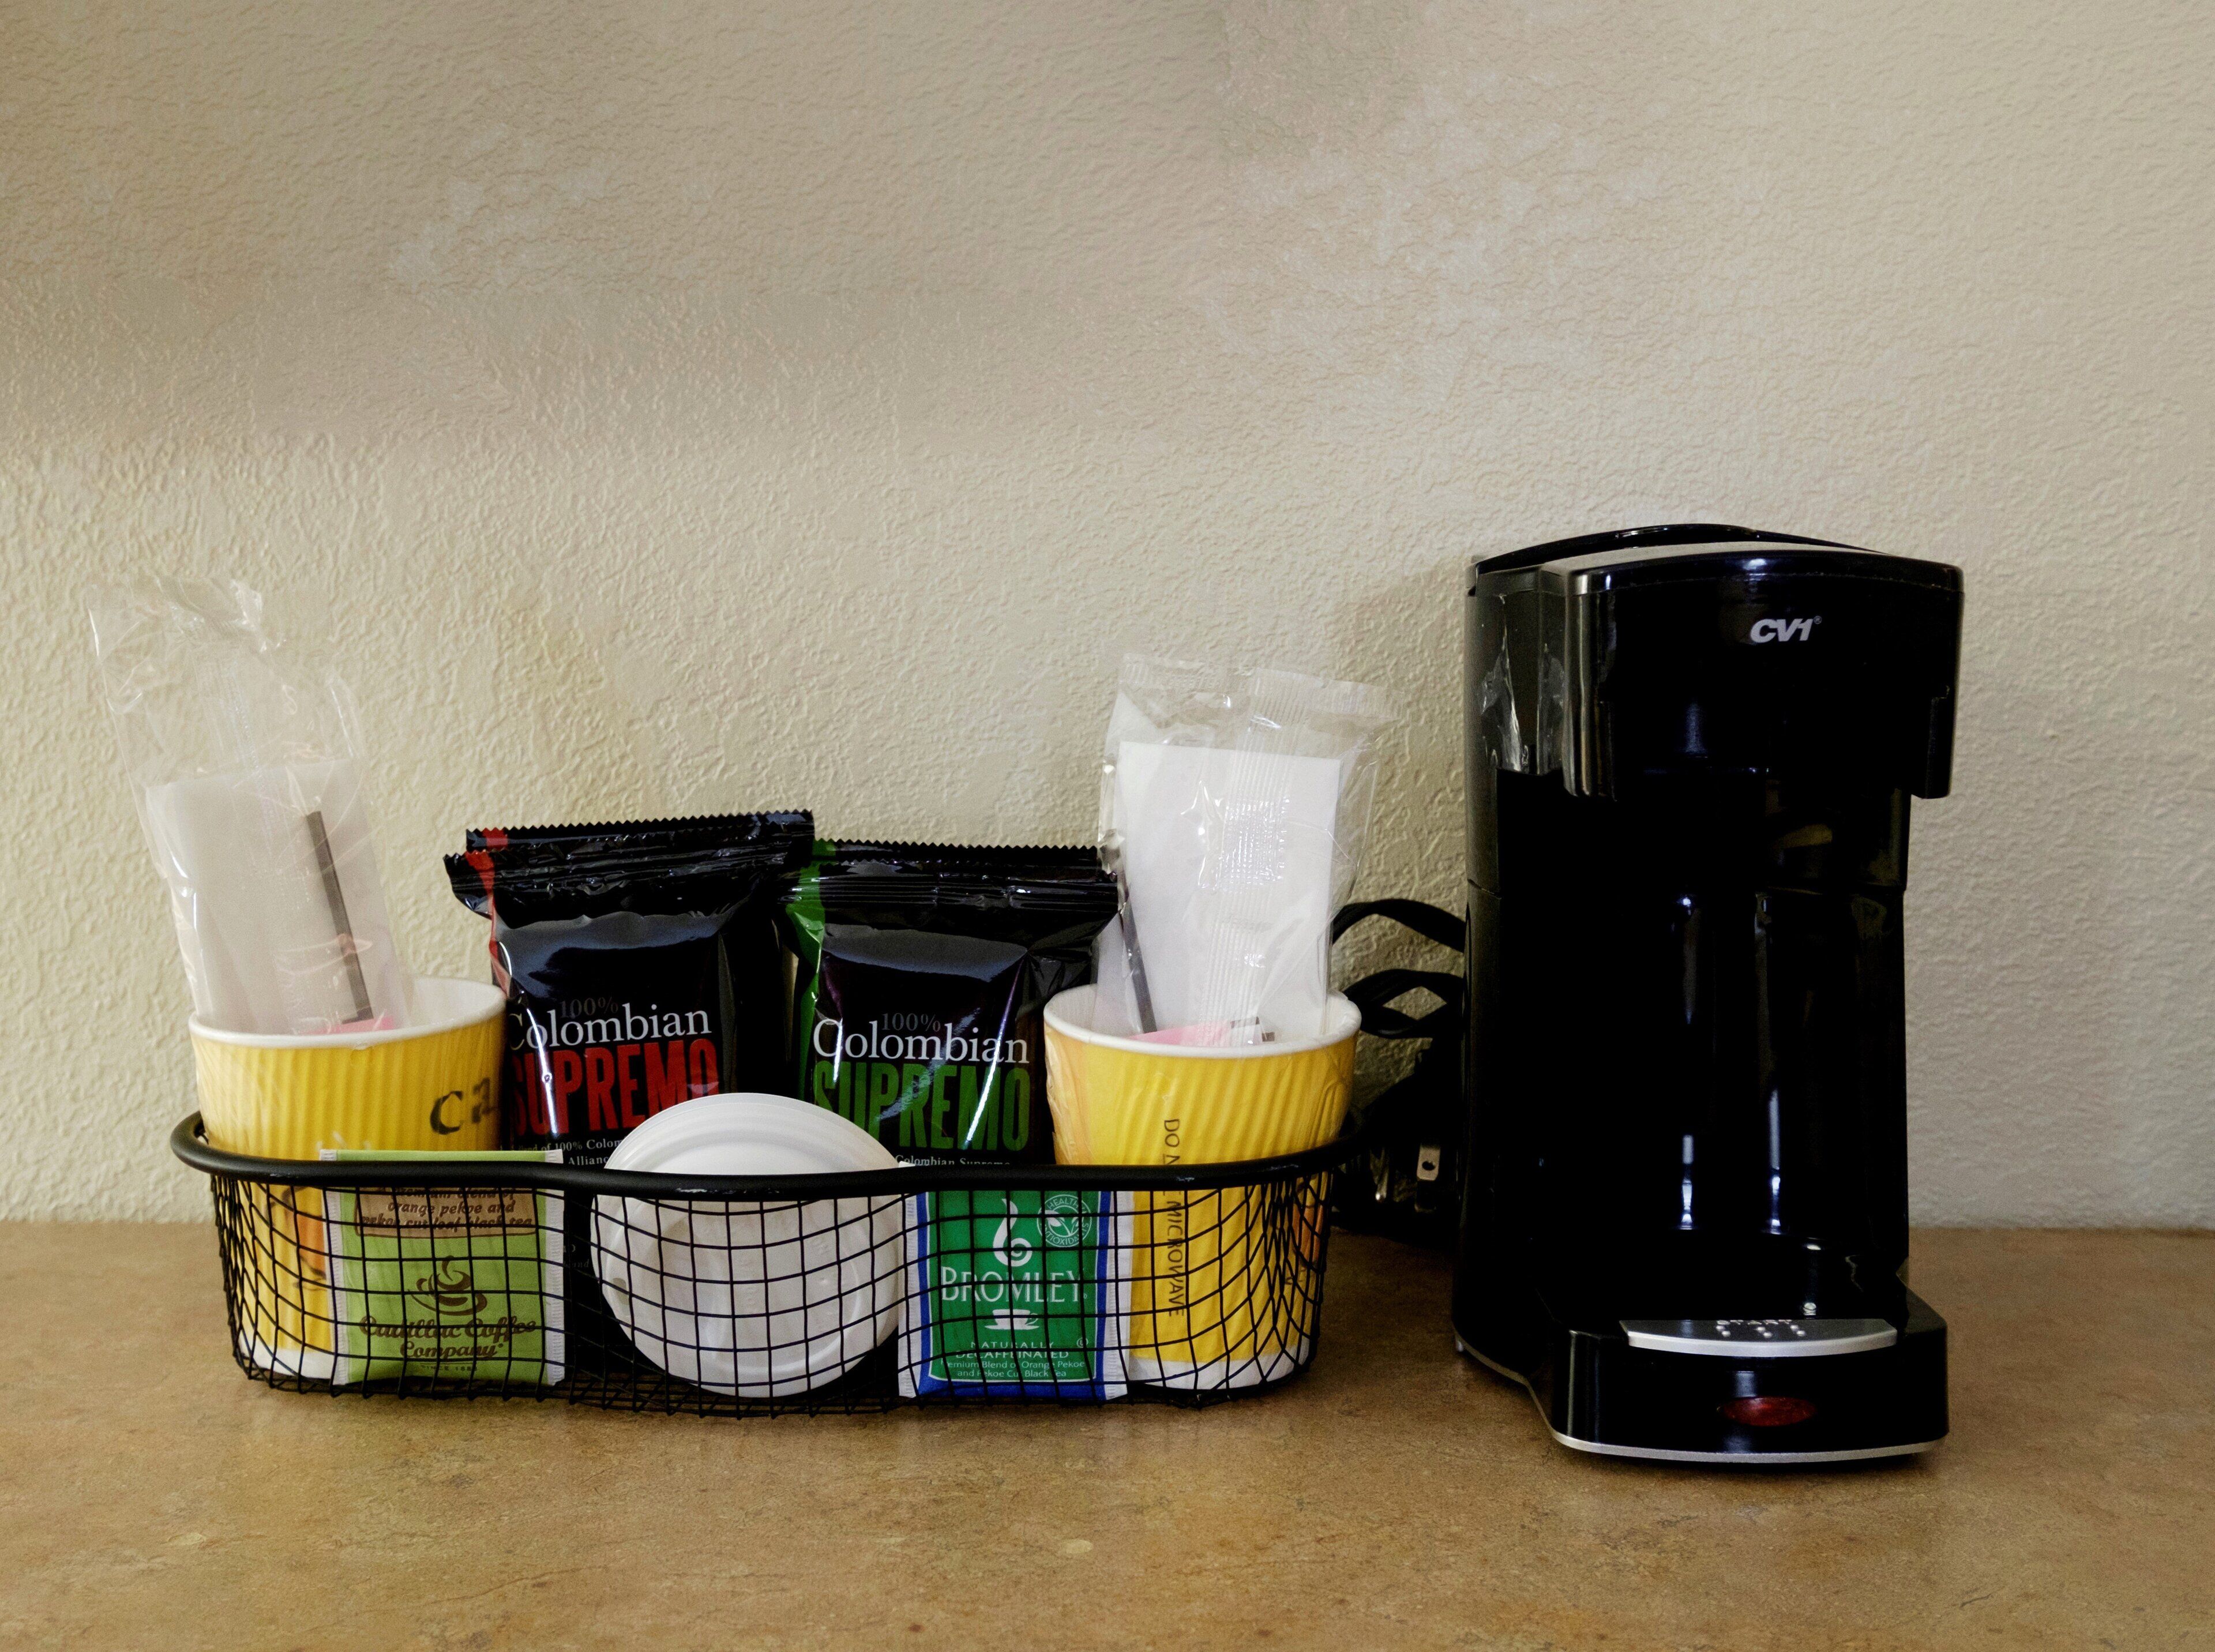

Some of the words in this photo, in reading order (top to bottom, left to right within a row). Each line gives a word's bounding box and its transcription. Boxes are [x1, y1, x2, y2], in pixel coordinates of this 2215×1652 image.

[560, 997, 618, 1019] 100%
[881, 1012, 941, 1032] 100%
[507, 1003, 713, 1051] Colombian
[813, 1019, 1030, 1064] Colombian
[509, 1038, 719, 1137] SUPREMO
[813, 1060, 1031, 1151] SUPREMO
[1164, 1118, 1180, 1147] DO
[388, 1202, 435, 1217] orange
[487, 1200, 516, 1213] and
[1166, 1201, 1184, 1317] MICROWAVE
[941, 1266, 1082, 1302] BROMLEY
[359, 1316, 463, 1339] Cadillac
[464, 1316, 536, 1344] Coffee
[400, 1341, 499, 1360] Company
[940, 1358, 979, 1368] emium
[982, 1360, 1008, 1368] Blend
[1022, 1361, 1055, 1370] Orang
